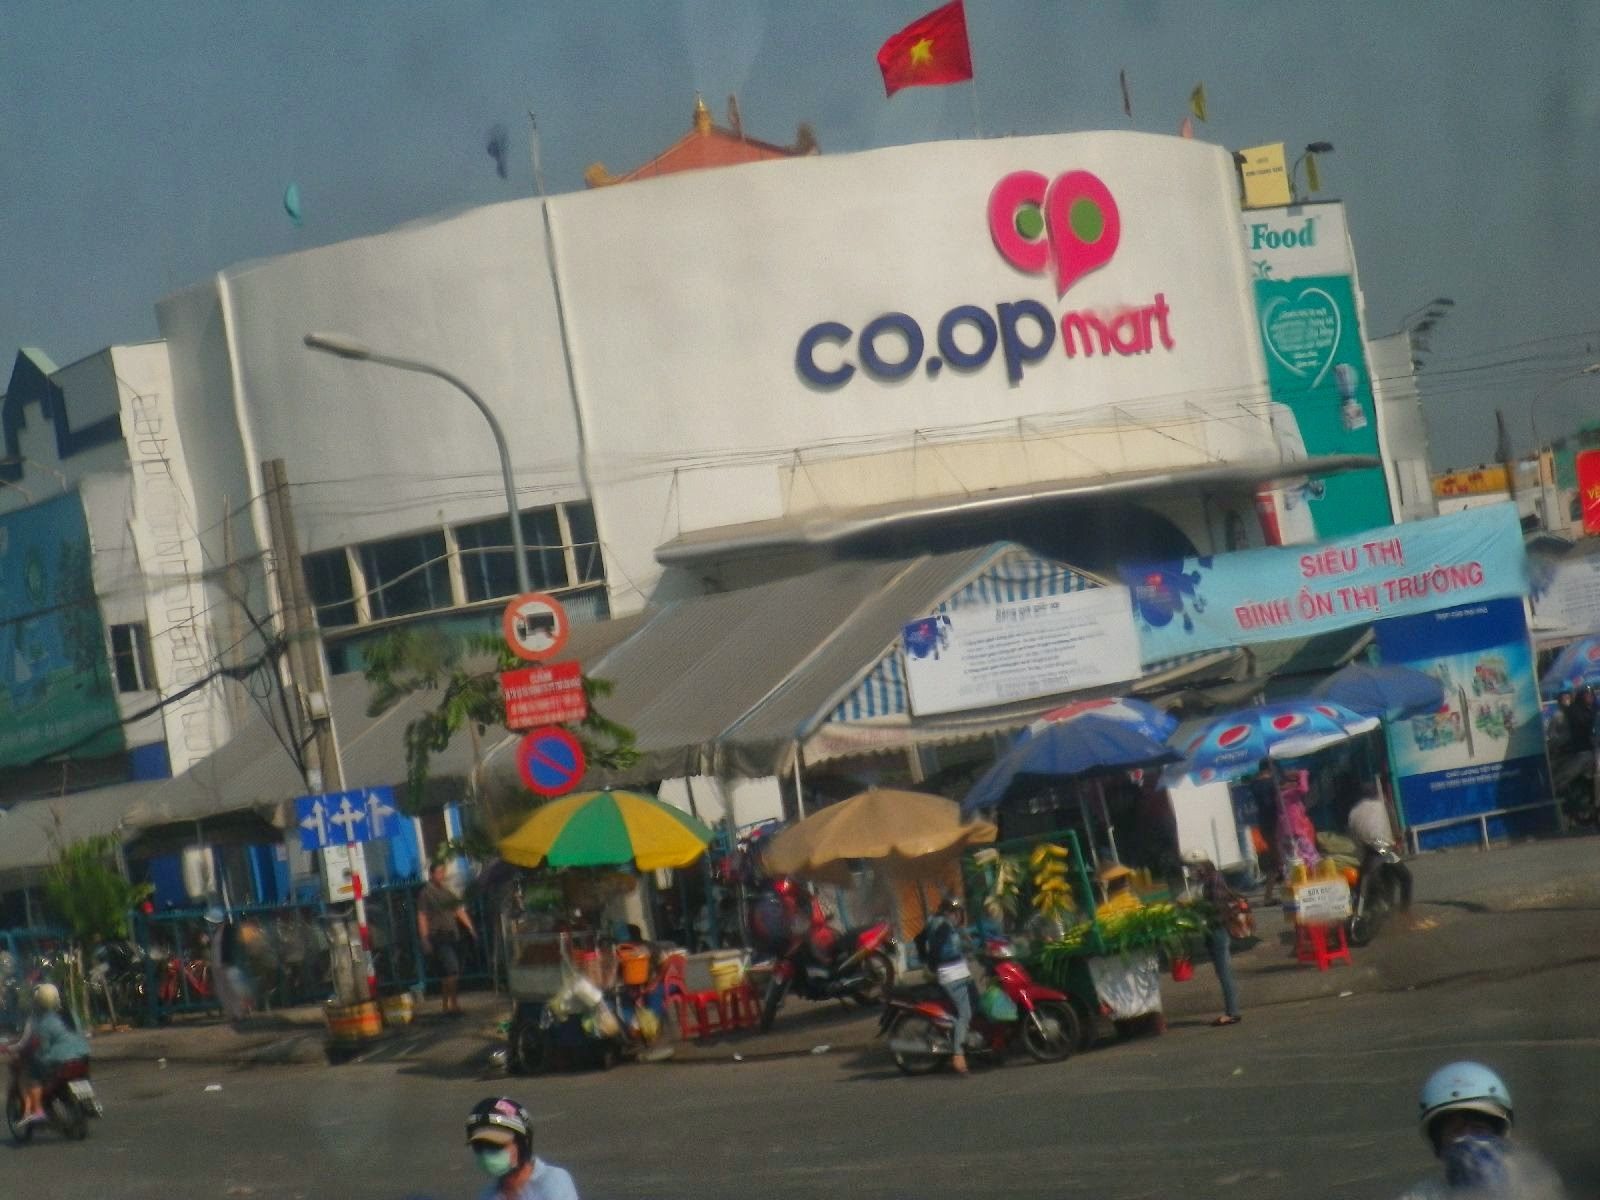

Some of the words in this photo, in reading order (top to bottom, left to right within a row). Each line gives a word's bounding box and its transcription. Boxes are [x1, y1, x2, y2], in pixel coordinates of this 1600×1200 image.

[1251, 218, 1315, 249] Food
[795, 299, 1056, 389] co.op
[1061, 293, 1174, 358] mart
[1301, 547, 1358, 579] SIÊU
[1363, 538, 1403, 568] THỊ
[1338, 587, 1380, 613] THỊ
[1385, 561, 1483, 601] TRƯỜNG
